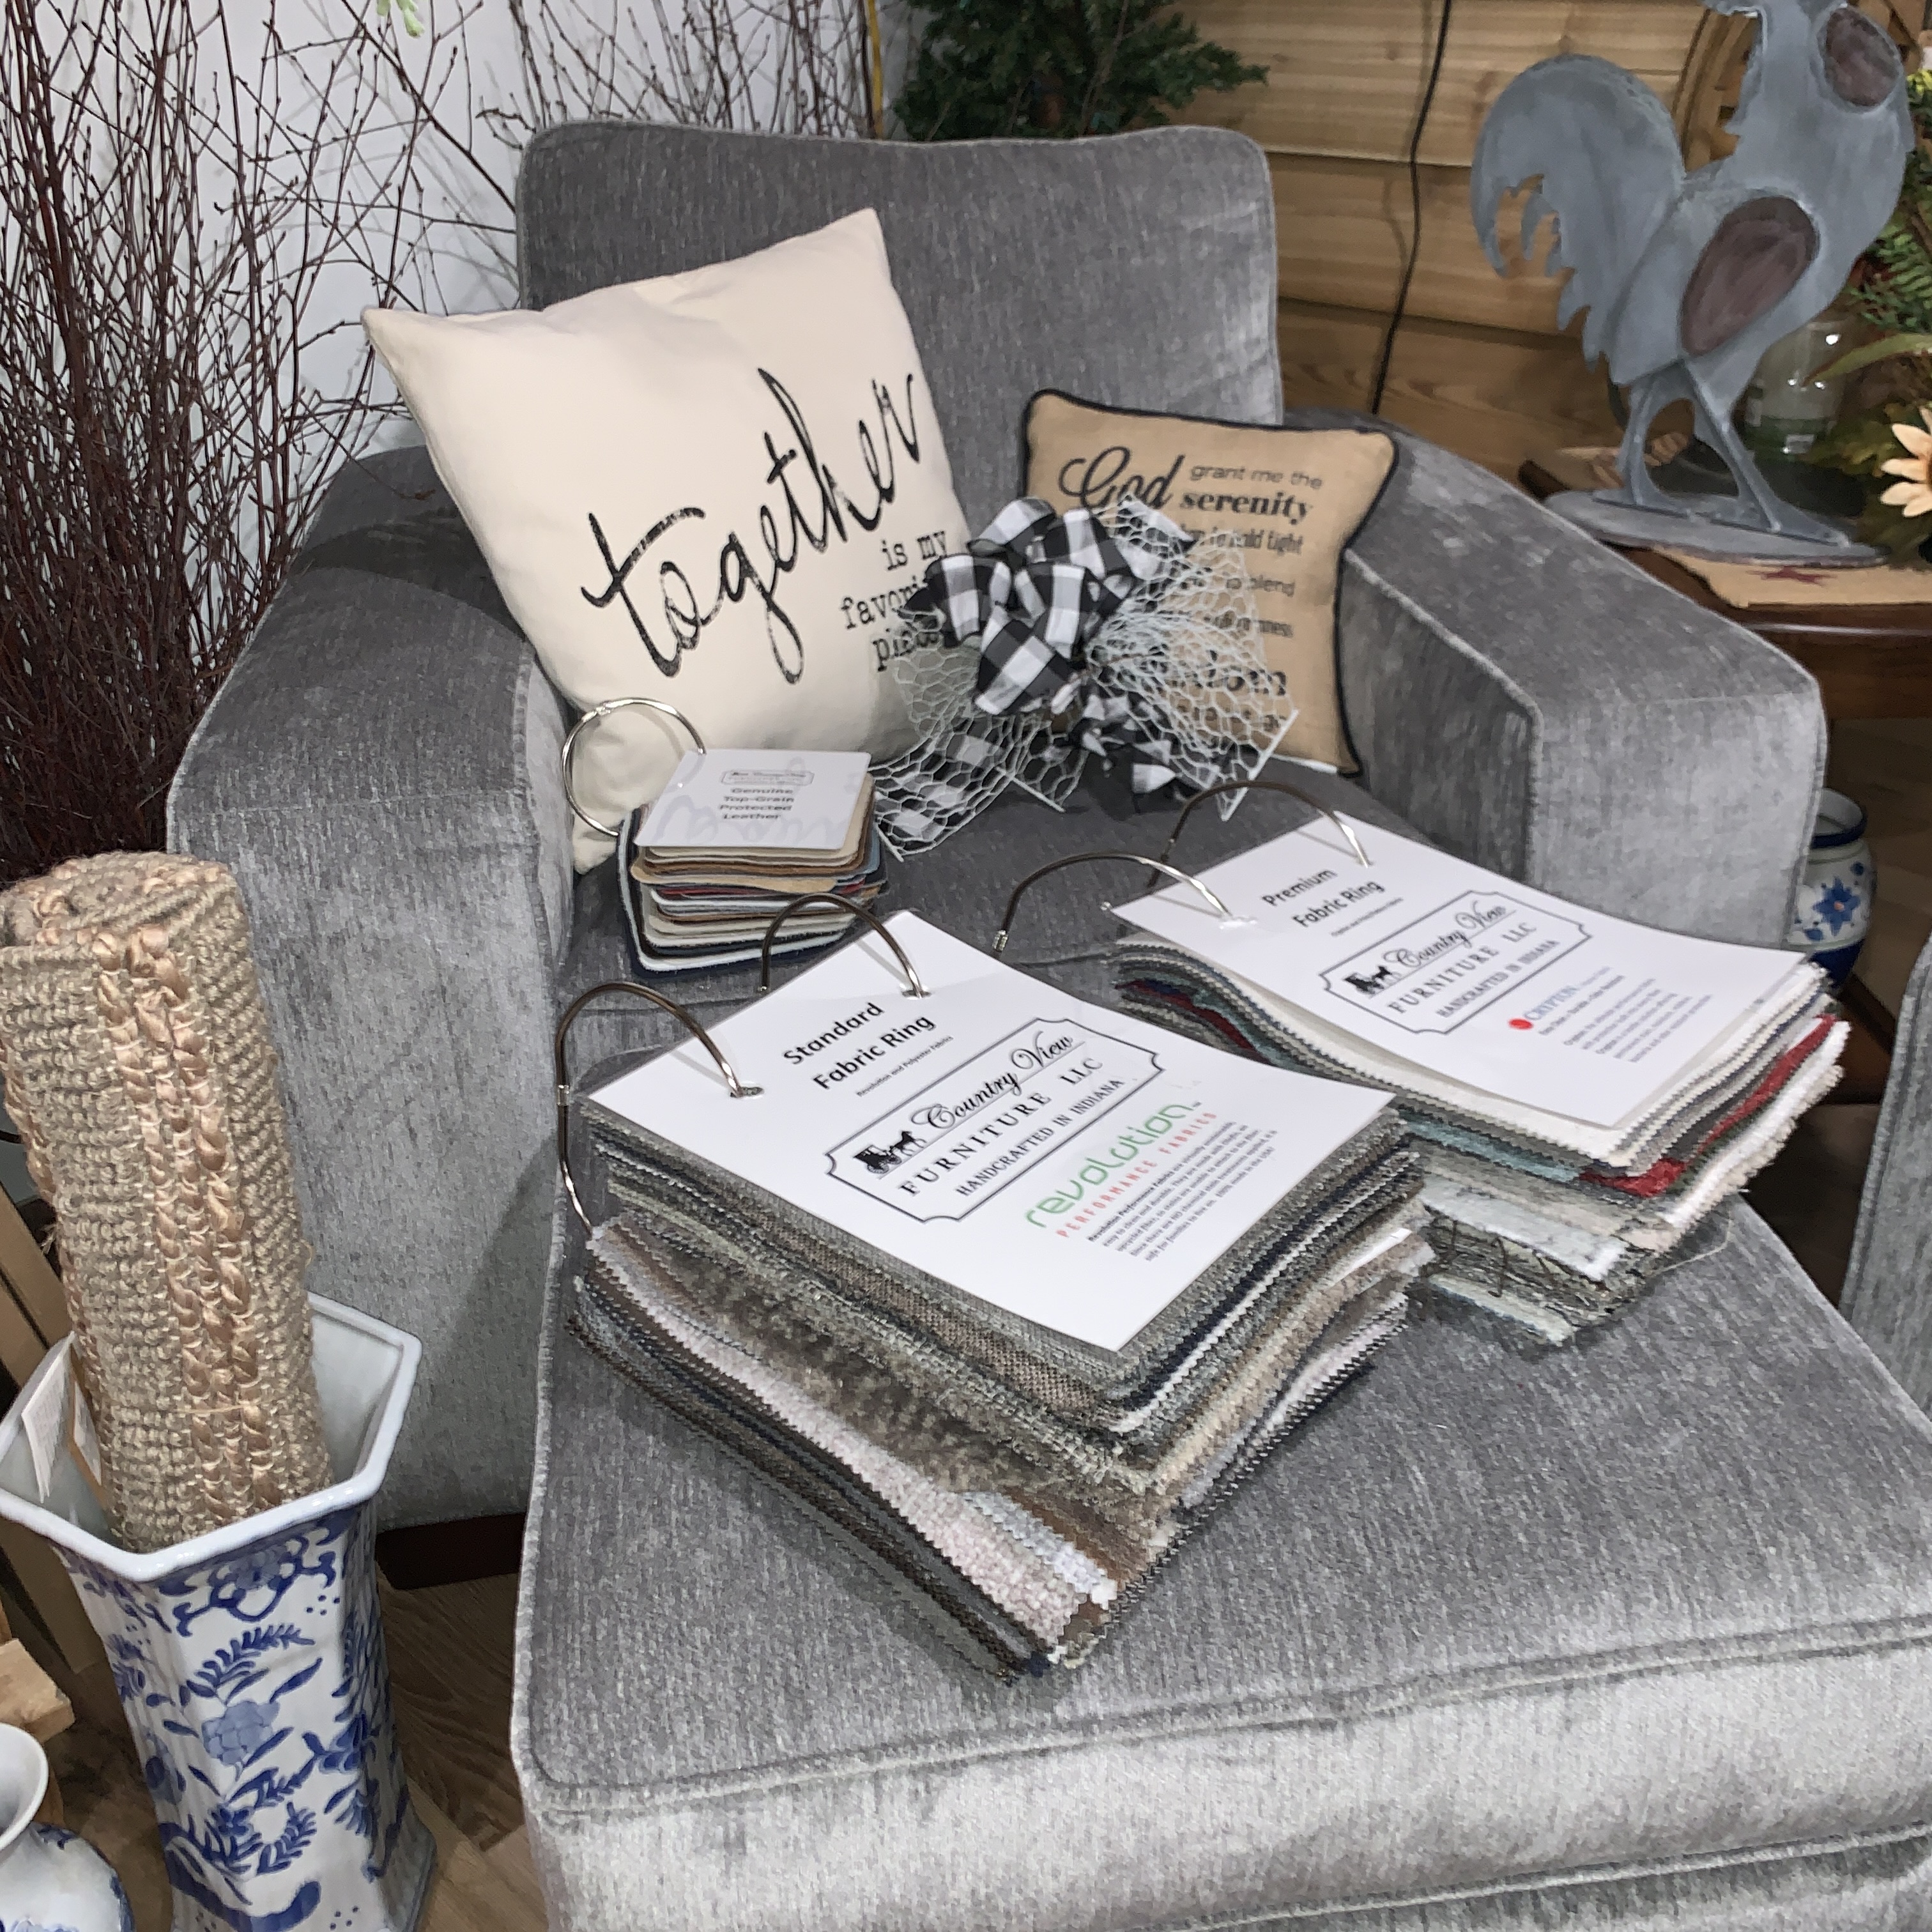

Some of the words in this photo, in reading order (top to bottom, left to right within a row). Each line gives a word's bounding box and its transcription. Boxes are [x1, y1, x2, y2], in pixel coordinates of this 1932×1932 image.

[1058, 446, 1186, 510] God
[1190, 464, 1246, 482] grant
[1251, 468, 1284, 484] me
[1291, 471, 1323, 489] the
[1179, 491, 1312, 525] serenity
[581, 367, 921, 685] together
[882, 540, 908, 571] is
[1261, 869, 1338, 907] Premium
[1292, 898, 1347, 927] Fabric
[1340, 881, 1385, 904] Ring
[1383, 930, 1472, 967] Country
[1388, 946, 1499, 1014] FURNITURE
[1501, 922, 1537, 942] LLC
[783, 1002, 884, 1065] Standard
[813, 1046, 886, 1090] Fabric
[880, 1016, 936, 1048] Ring
[910, 1070, 1022, 1130] Country
[1010, 1030, 1074, 1069] View
[898, 1092, 1052, 1197] FURNITURE
[1059, 1057, 1104, 1086] LLC
[954, 1127, 1055, 1197] HANDCRAFTED
[1053, 1114, 1073, 1127] IN
[1070, 1078, 1124, 1116] INDIANA
[1025, 1104, 1193, 1228] revolution
[1056, 1160, 1157, 1238] PERFORMANCE
